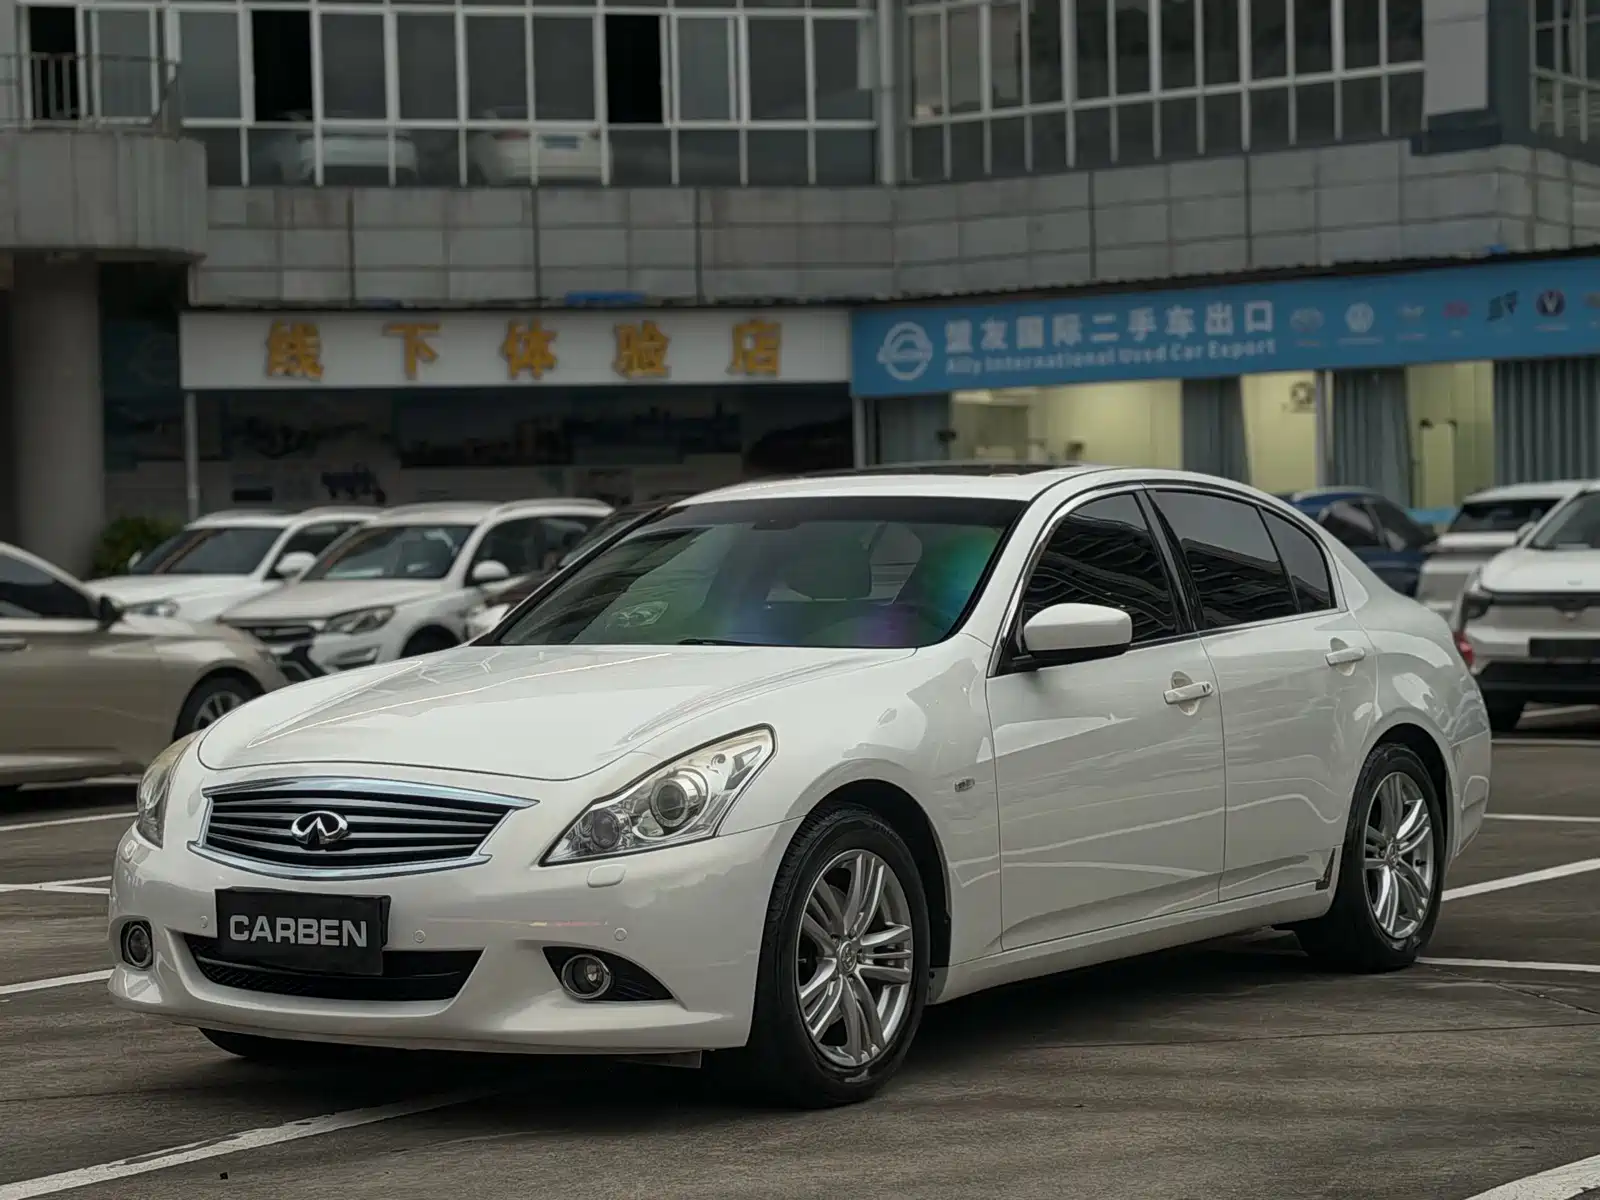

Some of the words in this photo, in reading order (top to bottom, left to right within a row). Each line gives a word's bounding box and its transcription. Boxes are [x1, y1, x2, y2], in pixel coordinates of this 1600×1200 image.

[265, 318, 783, 382] 线下体验店
[1170, 340, 1203, 361] Car
[1208, 337, 1276, 360] Export
[229, 914, 368, 948] CARBEN
